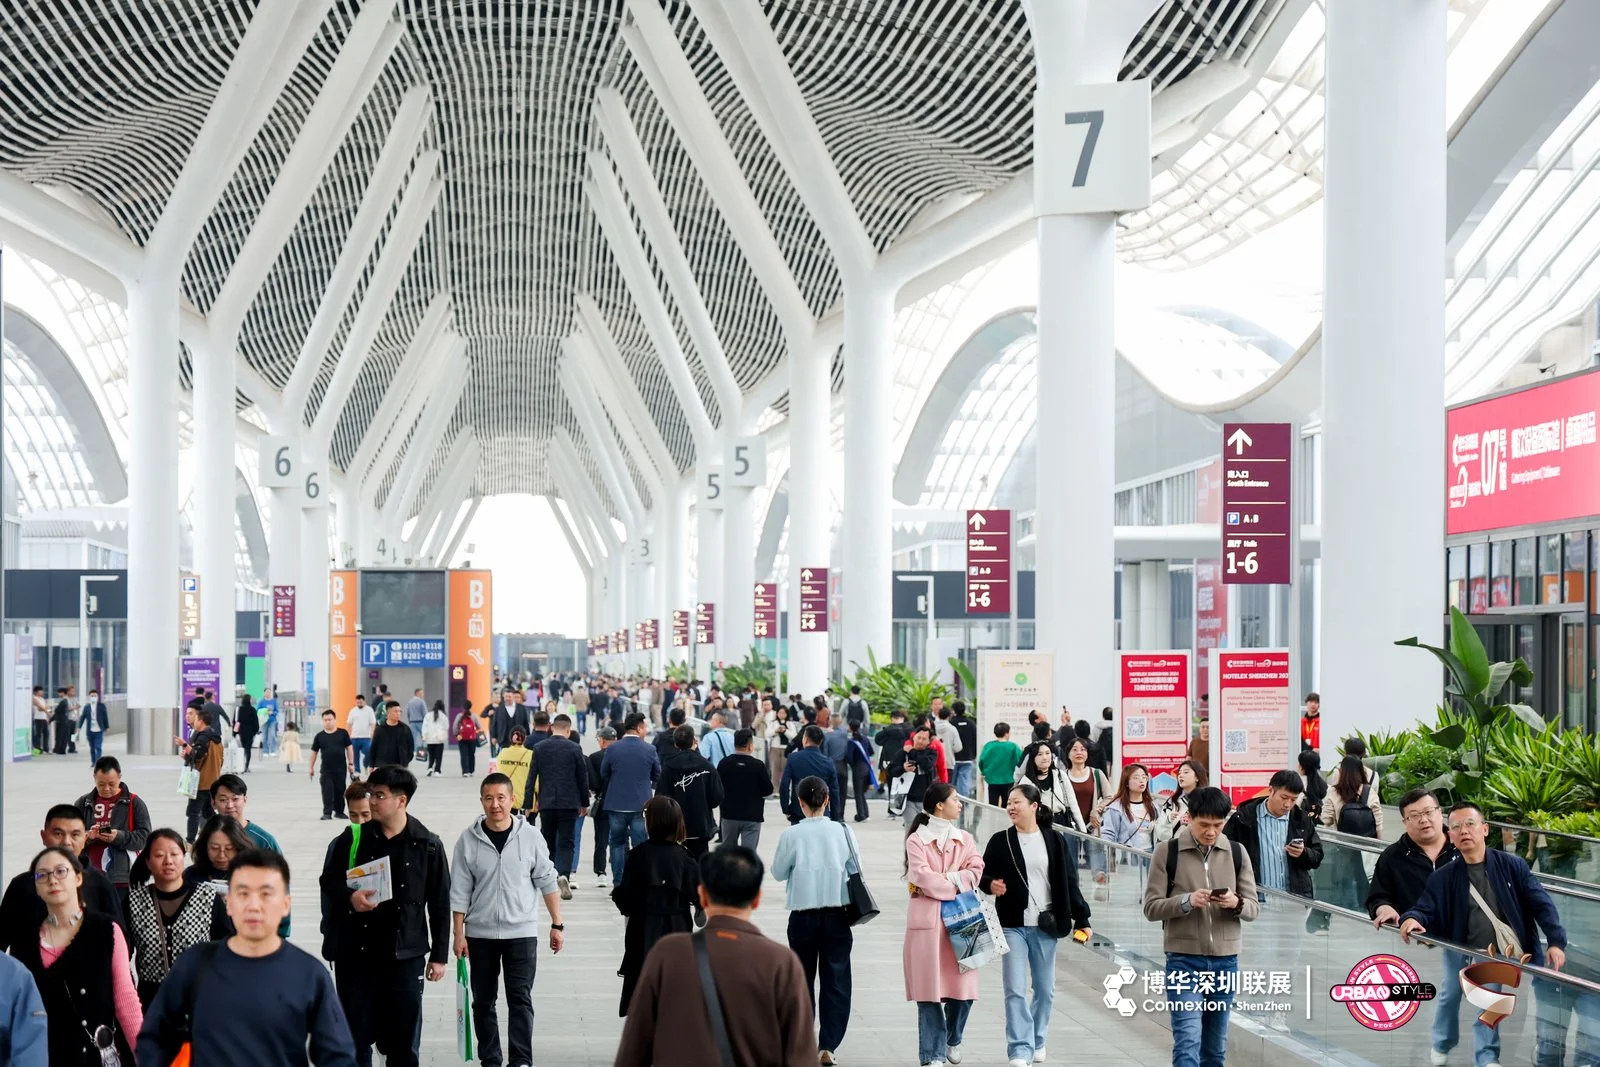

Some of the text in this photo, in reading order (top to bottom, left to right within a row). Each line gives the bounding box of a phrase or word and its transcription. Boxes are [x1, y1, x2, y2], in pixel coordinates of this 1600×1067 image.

[1064, 109, 1104, 188] 7
[274, 445, 291, 477] 6
[734, 446, 749, 476] 5
[1481, 428, 1500, 497] 07
[305, 471, 320, 499] 6
[706, 473, 720, 500] 5
[376, 538, 387, 556] 4
[640, 539, 650, 557] 3
[1226, 551, 1259, 574] 1-6
[333, 576, 345, 605] B
[469, 579, 484, 609] B
[968, 591, 991, 608] 1-6
[369, 644, 381, 662] P
